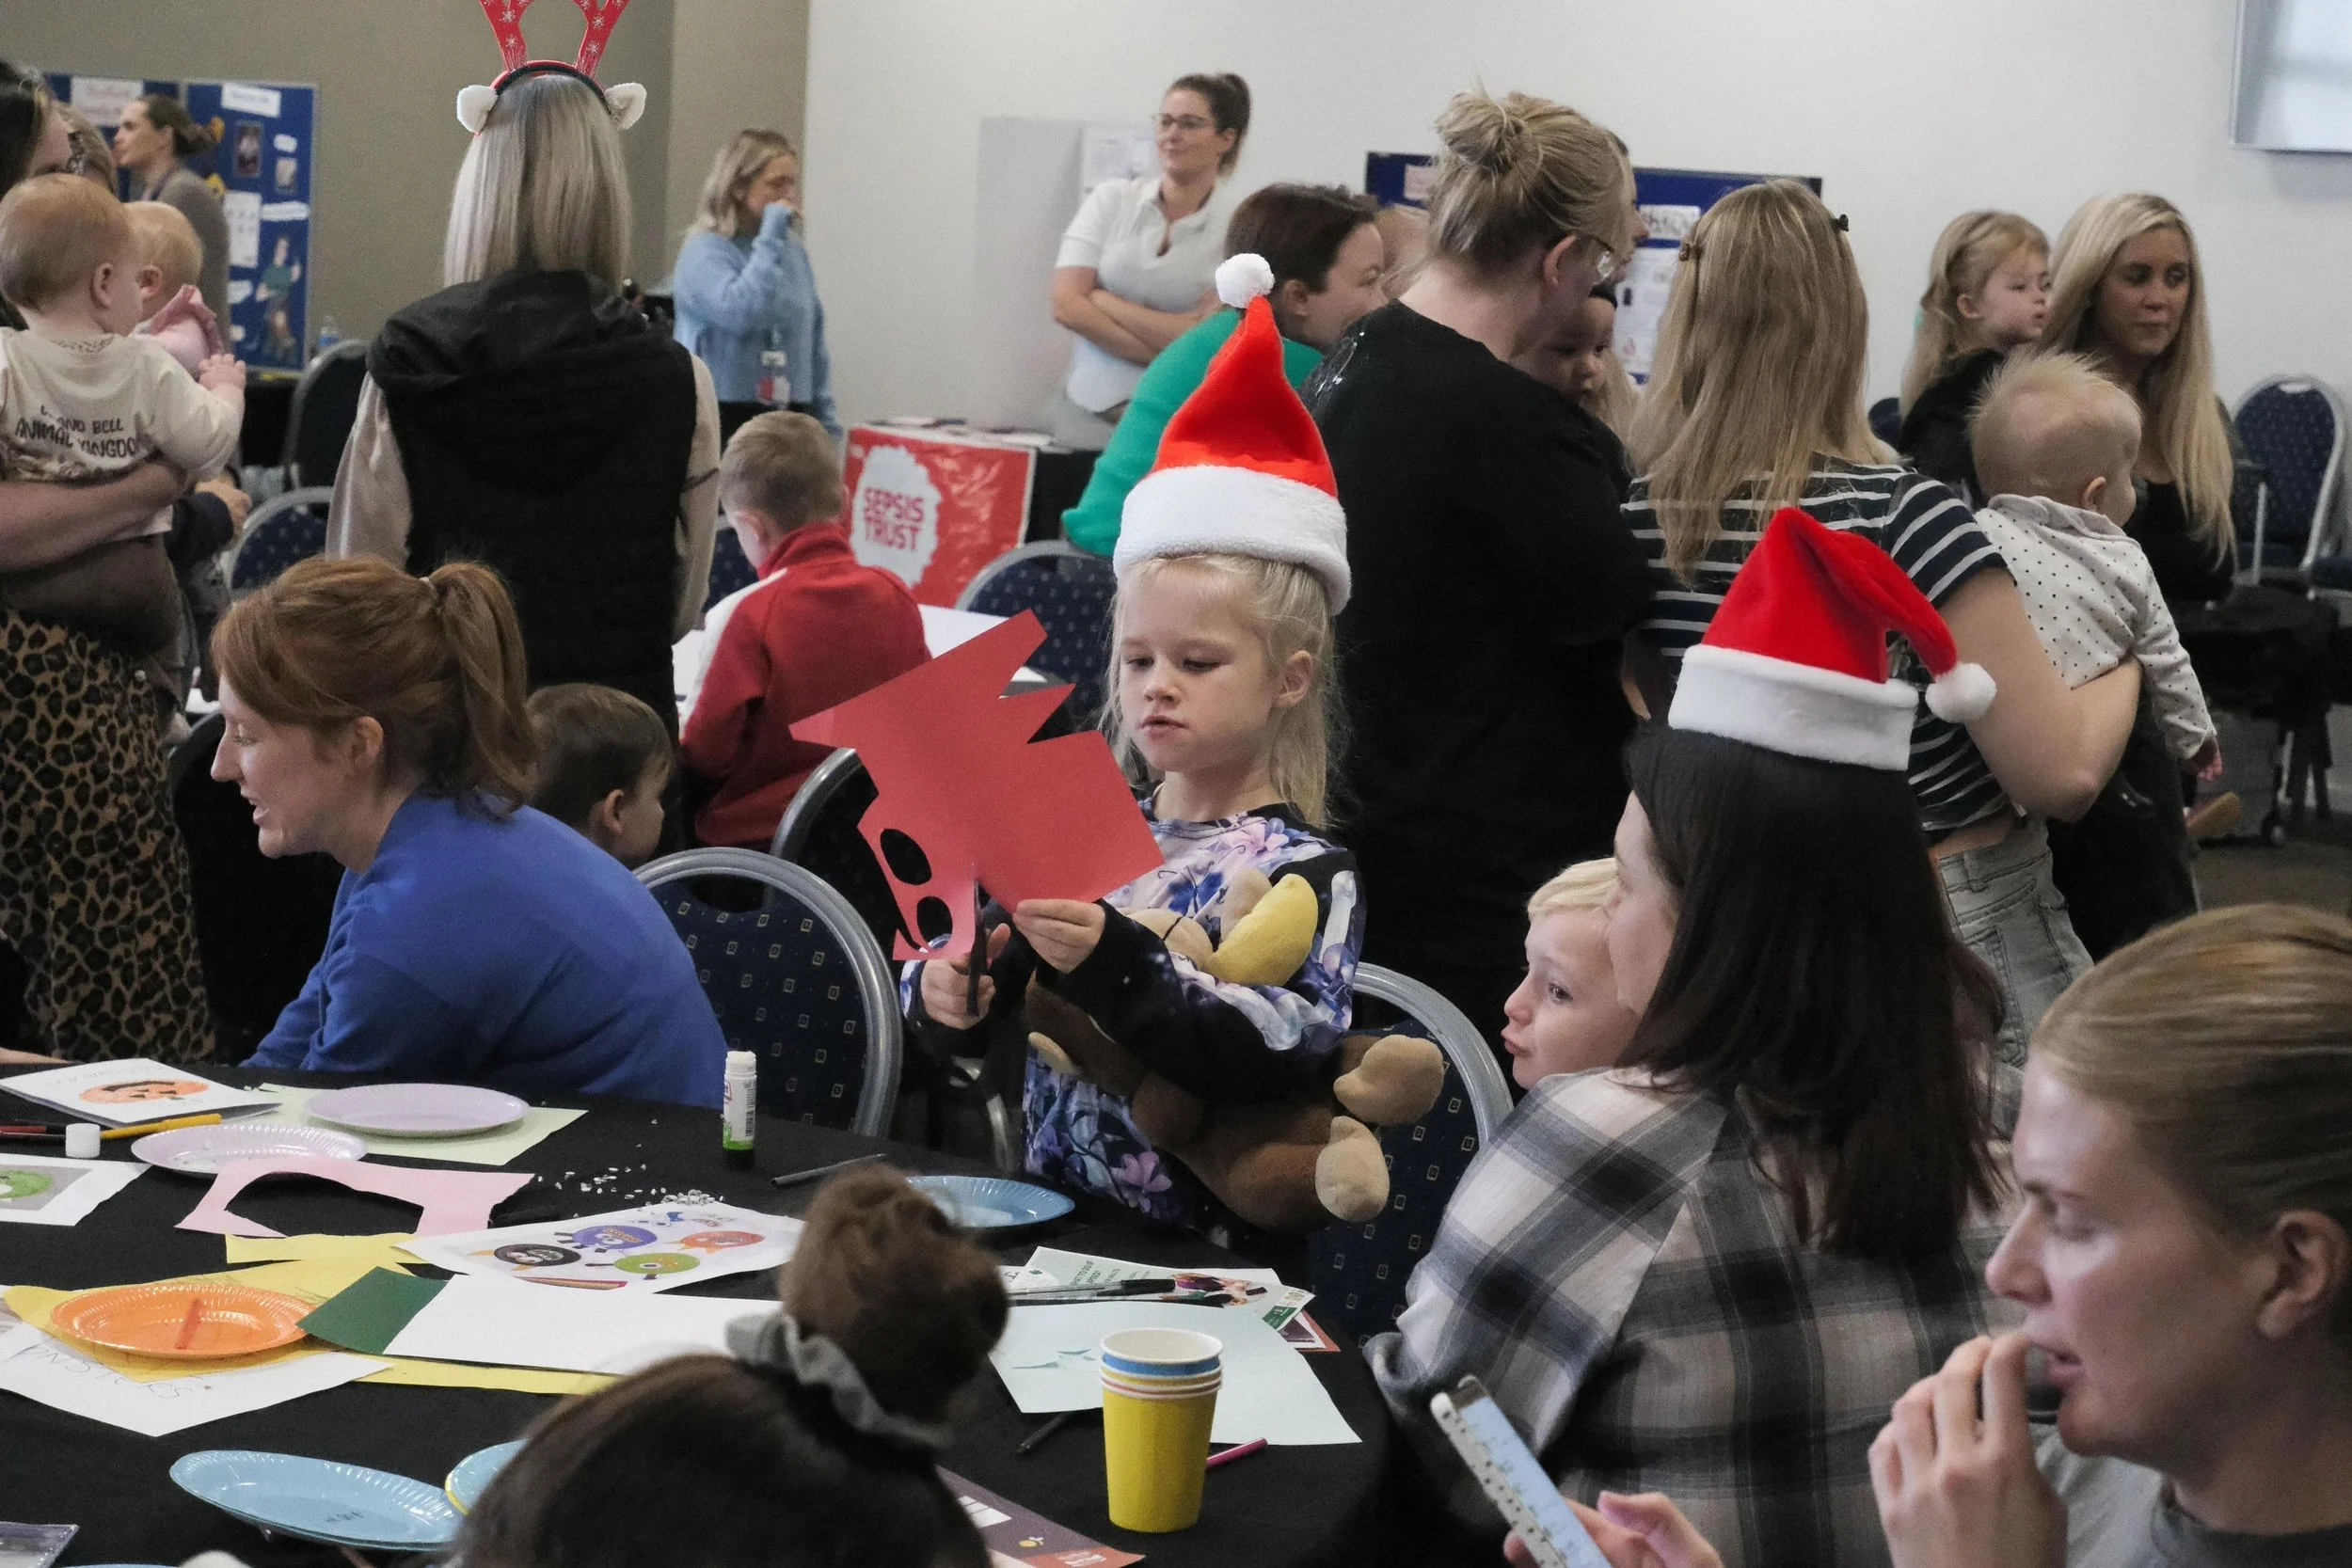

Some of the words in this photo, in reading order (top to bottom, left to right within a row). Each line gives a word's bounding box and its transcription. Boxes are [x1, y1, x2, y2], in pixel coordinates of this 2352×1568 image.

[15, 416, 73, 449] ANIMAL
[92, 418, 124, 435] BELL
[864, 486, 925, 524] SEPSIS
[864, 516, 921, 551] TRUST
